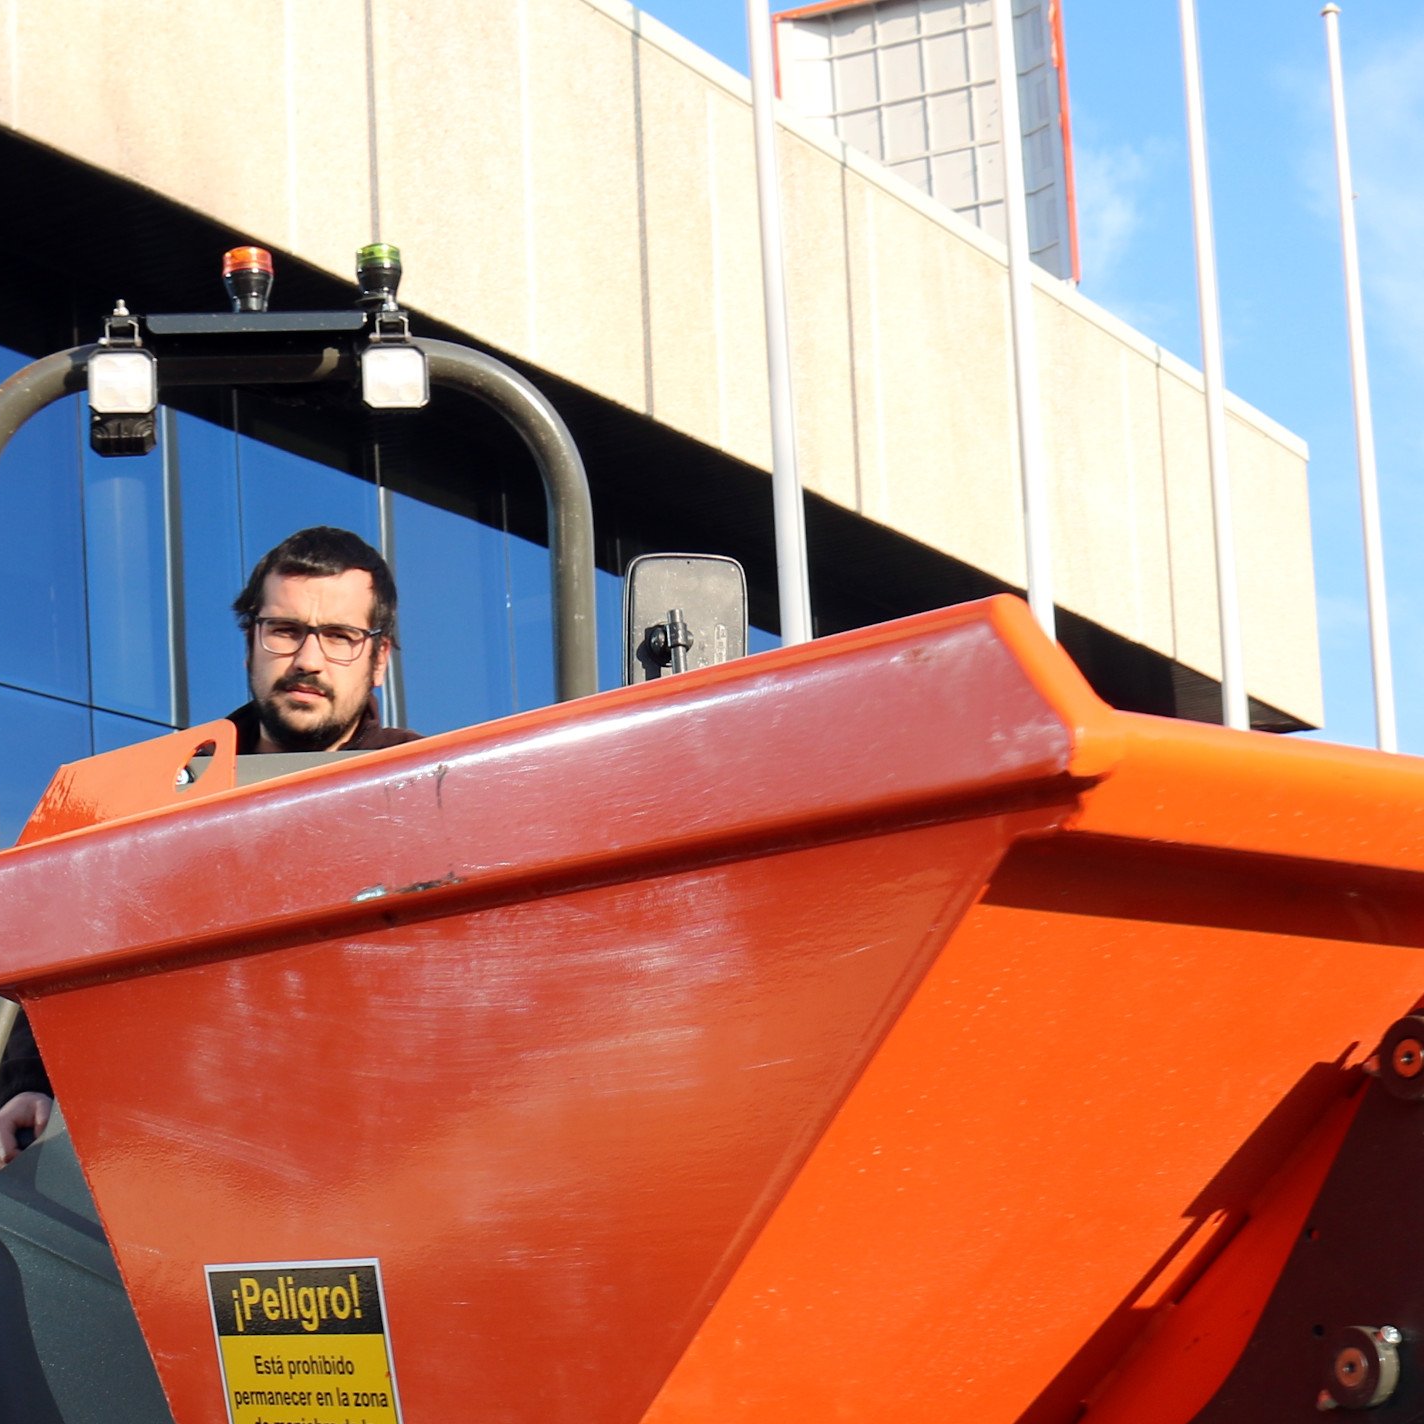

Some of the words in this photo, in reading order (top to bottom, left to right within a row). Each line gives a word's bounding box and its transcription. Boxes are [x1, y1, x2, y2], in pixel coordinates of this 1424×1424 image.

[232, 1274, 362, 1332] ¡Peligro!
[254, 1355, 285, 1375] Está
[288, 1355, 355, 1379] prohibido
[234, 1390, 312, 1409] permanecer
[316, 1391, 334, 1407] en
[336, 1387, 350, 1407] la
[353, 1392, 389, 1408] zona
